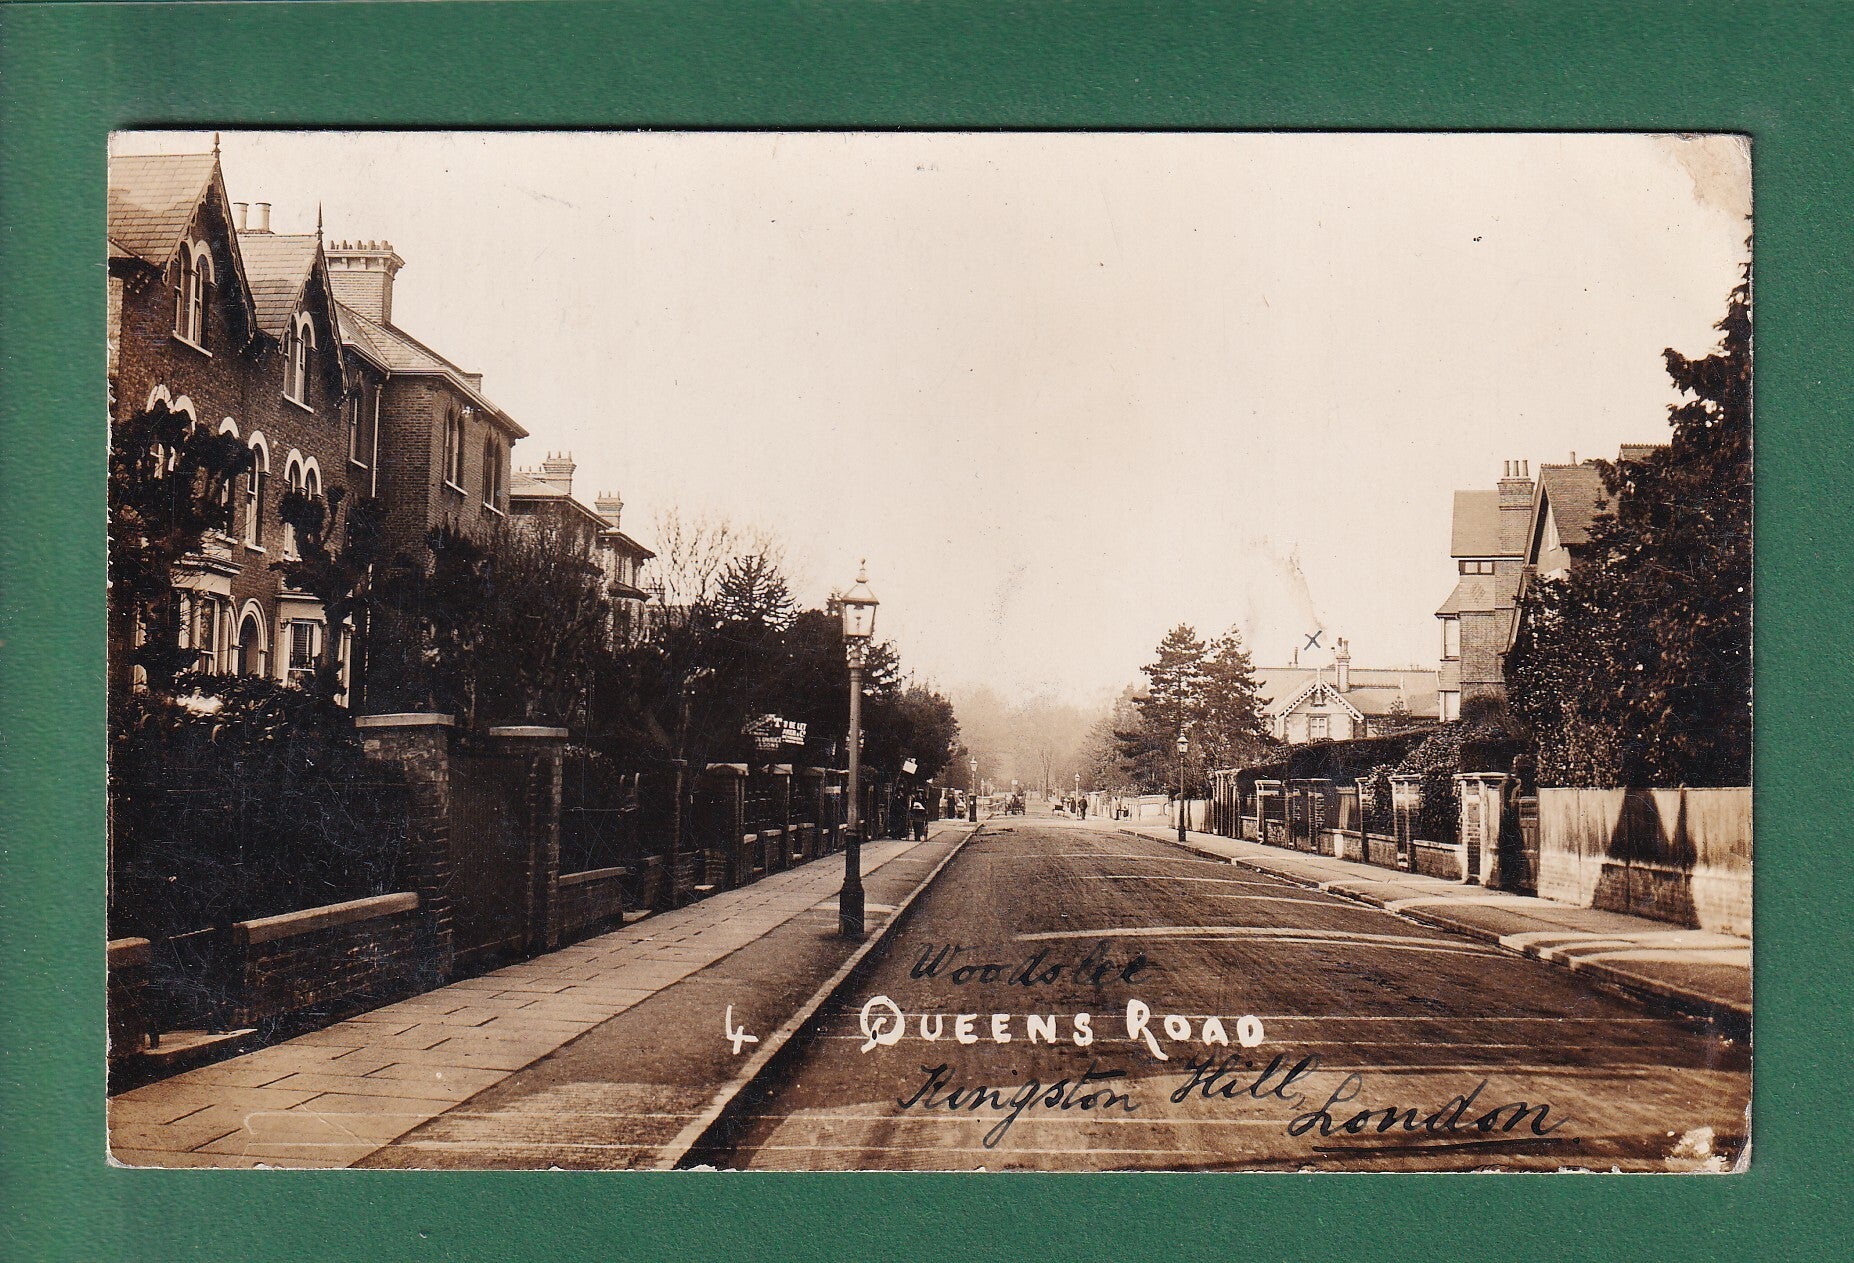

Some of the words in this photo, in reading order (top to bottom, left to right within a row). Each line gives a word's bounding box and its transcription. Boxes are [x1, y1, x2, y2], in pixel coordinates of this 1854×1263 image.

[797, 722, 808, 731] LET
[897, 1060, 1141, 1149] Kingston
[1287, 1073, 1568, 1137] London
